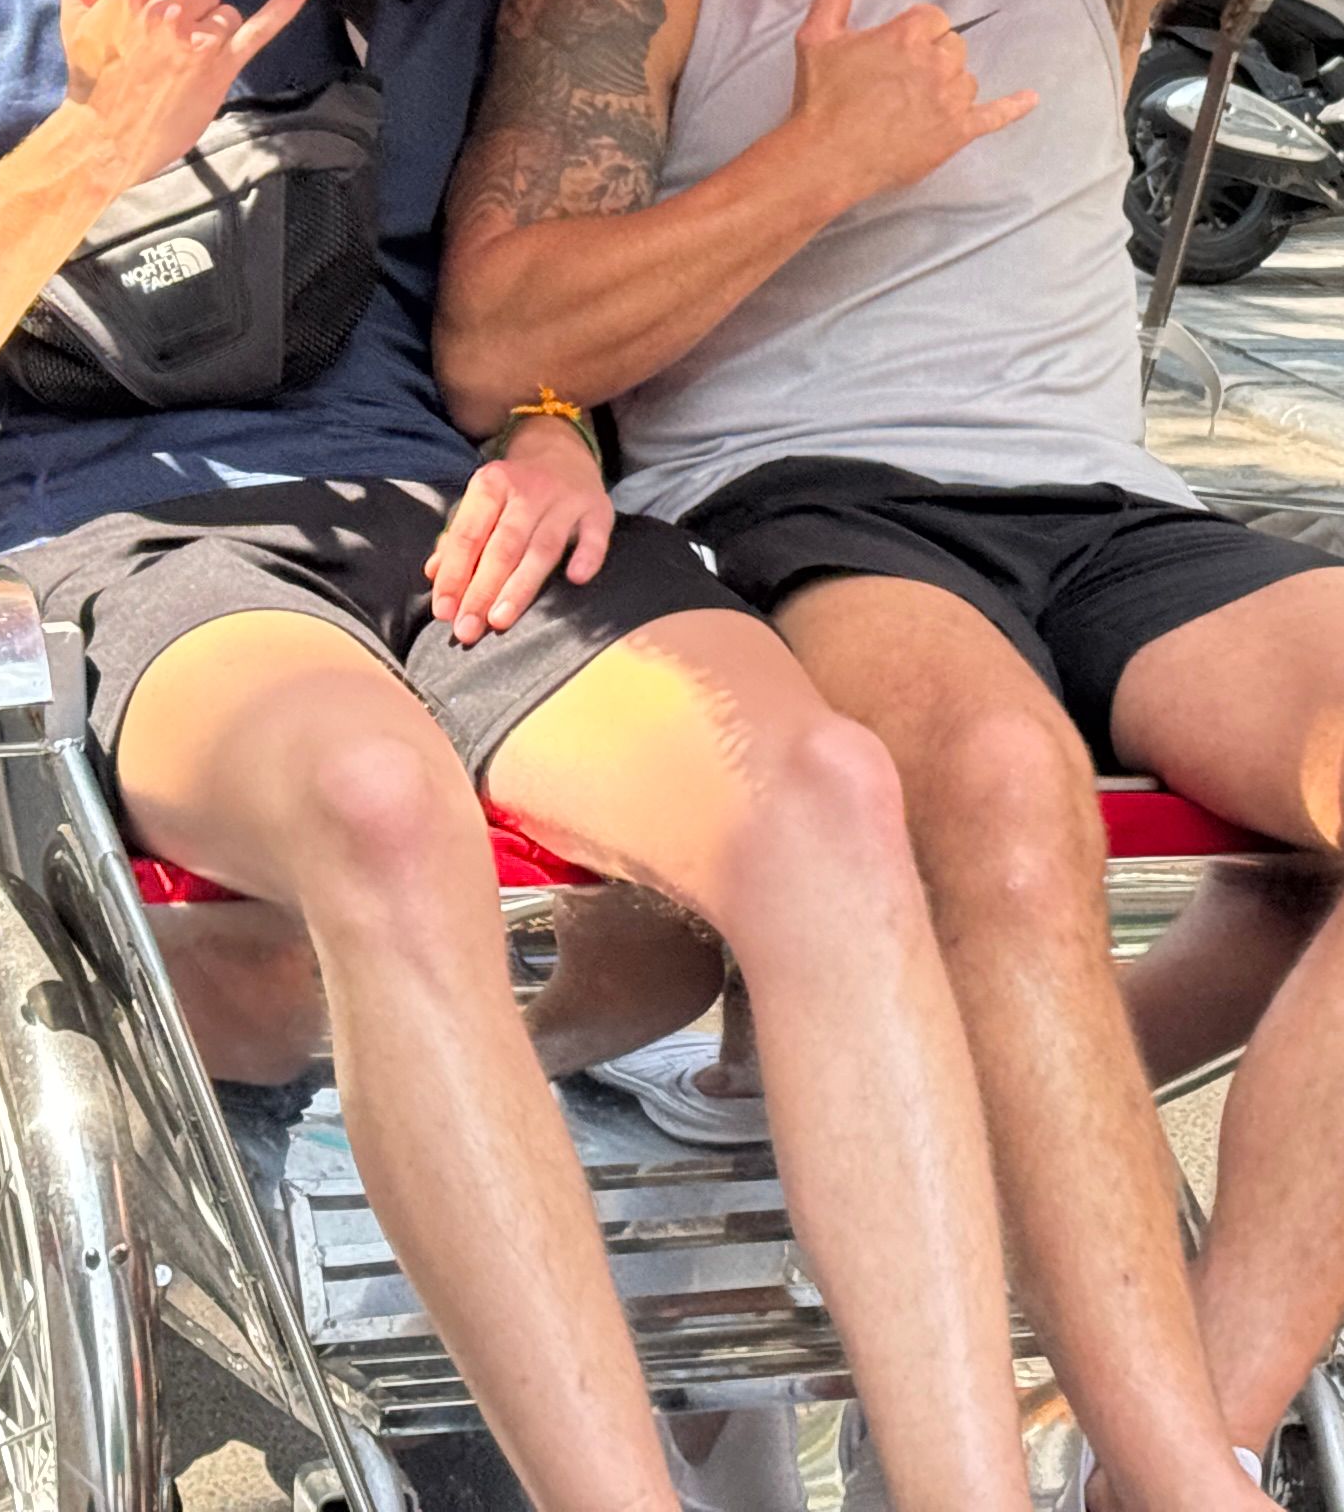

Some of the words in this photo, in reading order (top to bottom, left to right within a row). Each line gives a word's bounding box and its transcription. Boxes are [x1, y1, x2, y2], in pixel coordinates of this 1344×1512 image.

[139, 242, 173, 265] THE
[120, 253, 179, 288] NORTH
[140, 268, 184, 295] FACE
